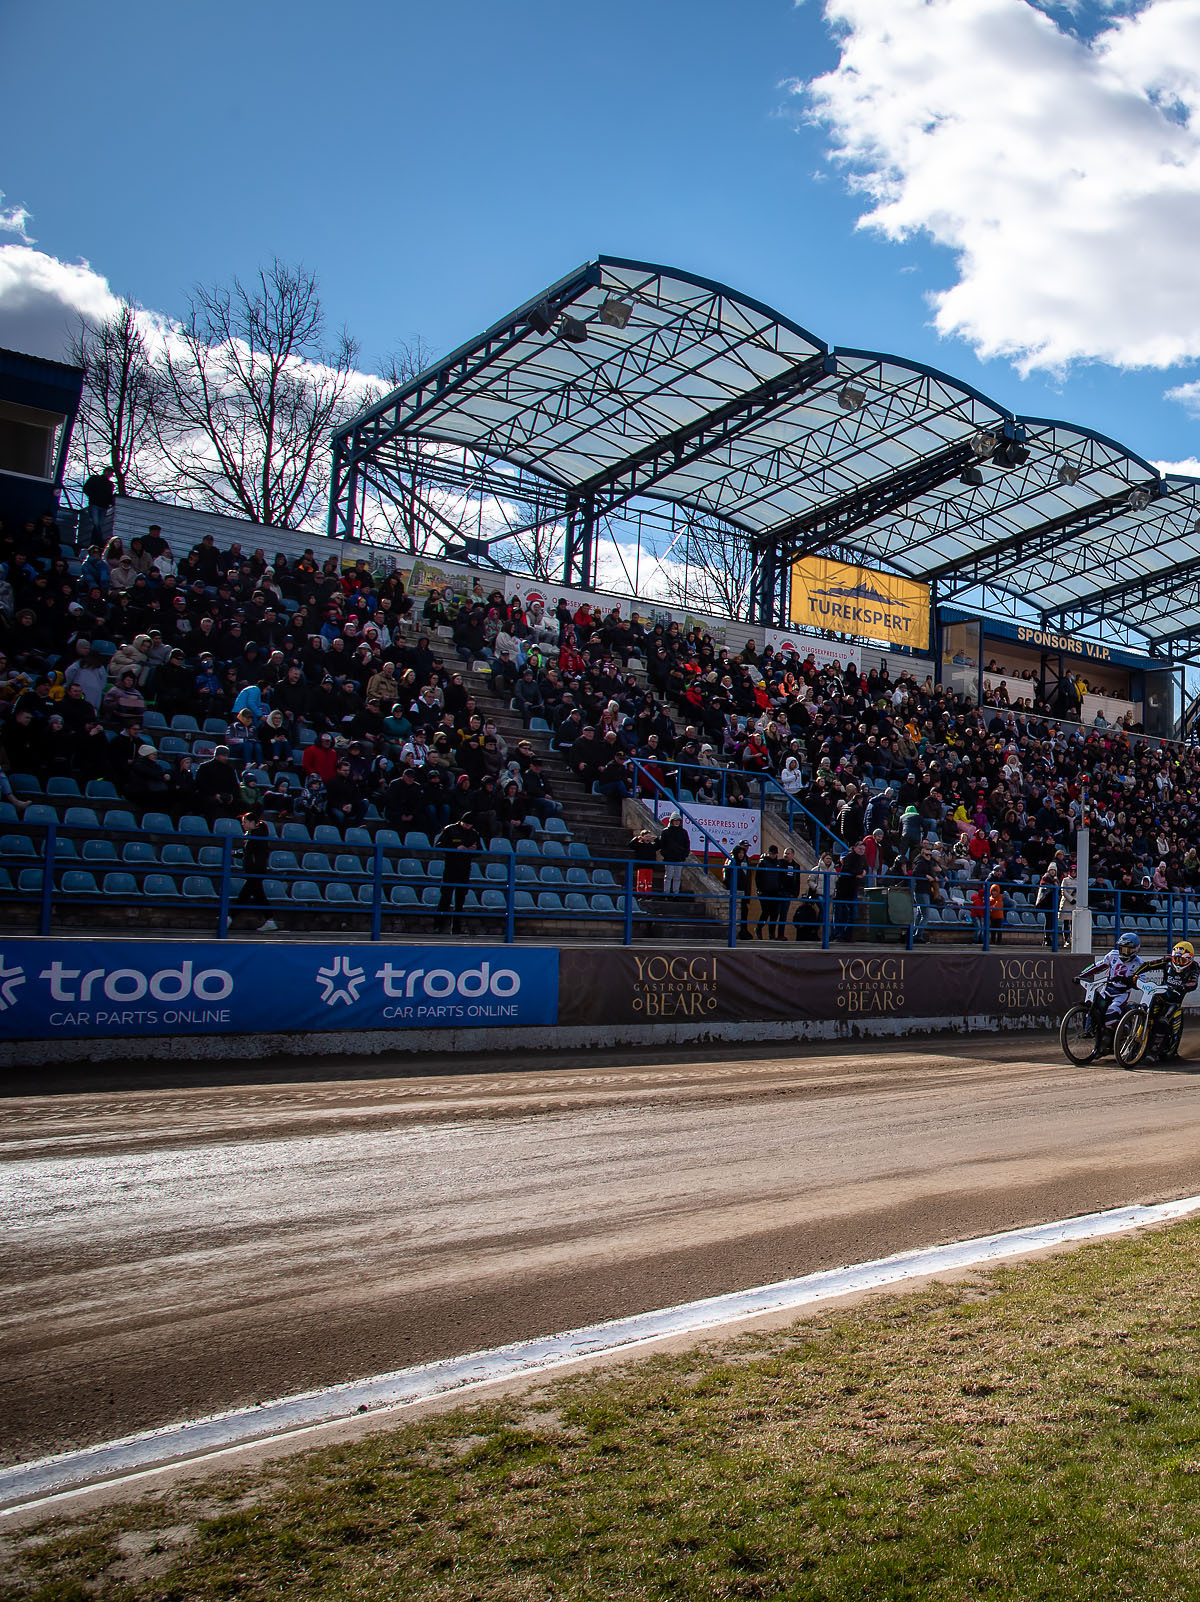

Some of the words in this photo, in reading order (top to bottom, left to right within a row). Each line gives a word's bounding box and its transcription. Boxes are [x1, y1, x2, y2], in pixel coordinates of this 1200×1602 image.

[808, 597, 912, 632] TUREKSPERT
[1017, 627, 1083, 654] SPONSORS
[1086, 644, 1111, 660] V.I.P.
[737, 821, 749, 829] LTD
[375, 961, 521, 998] trodo
[633, 956, 718, 981] YOGGI
[838, 958, 904, 981] YOGGI
[1000, 959, 1054, 979] YOGGI
[38, 960, 234, 1002] trodo
[646, 992, 707, 1016] BEAR
[848, 990, 896, 1011] BEAR
[1008, 988, 1047, 1007] BEAR
[49, 1011, 90, 1026] CAR
[96, 1010, 158, 1025] PARTS
[163, 1009, 231, 1024] ONLINE
[382, 1006, 413, 1018] CAR
[417, 1005, 464, 1017] PARTS
[467, 1004, 519, 1017] ONLINE
